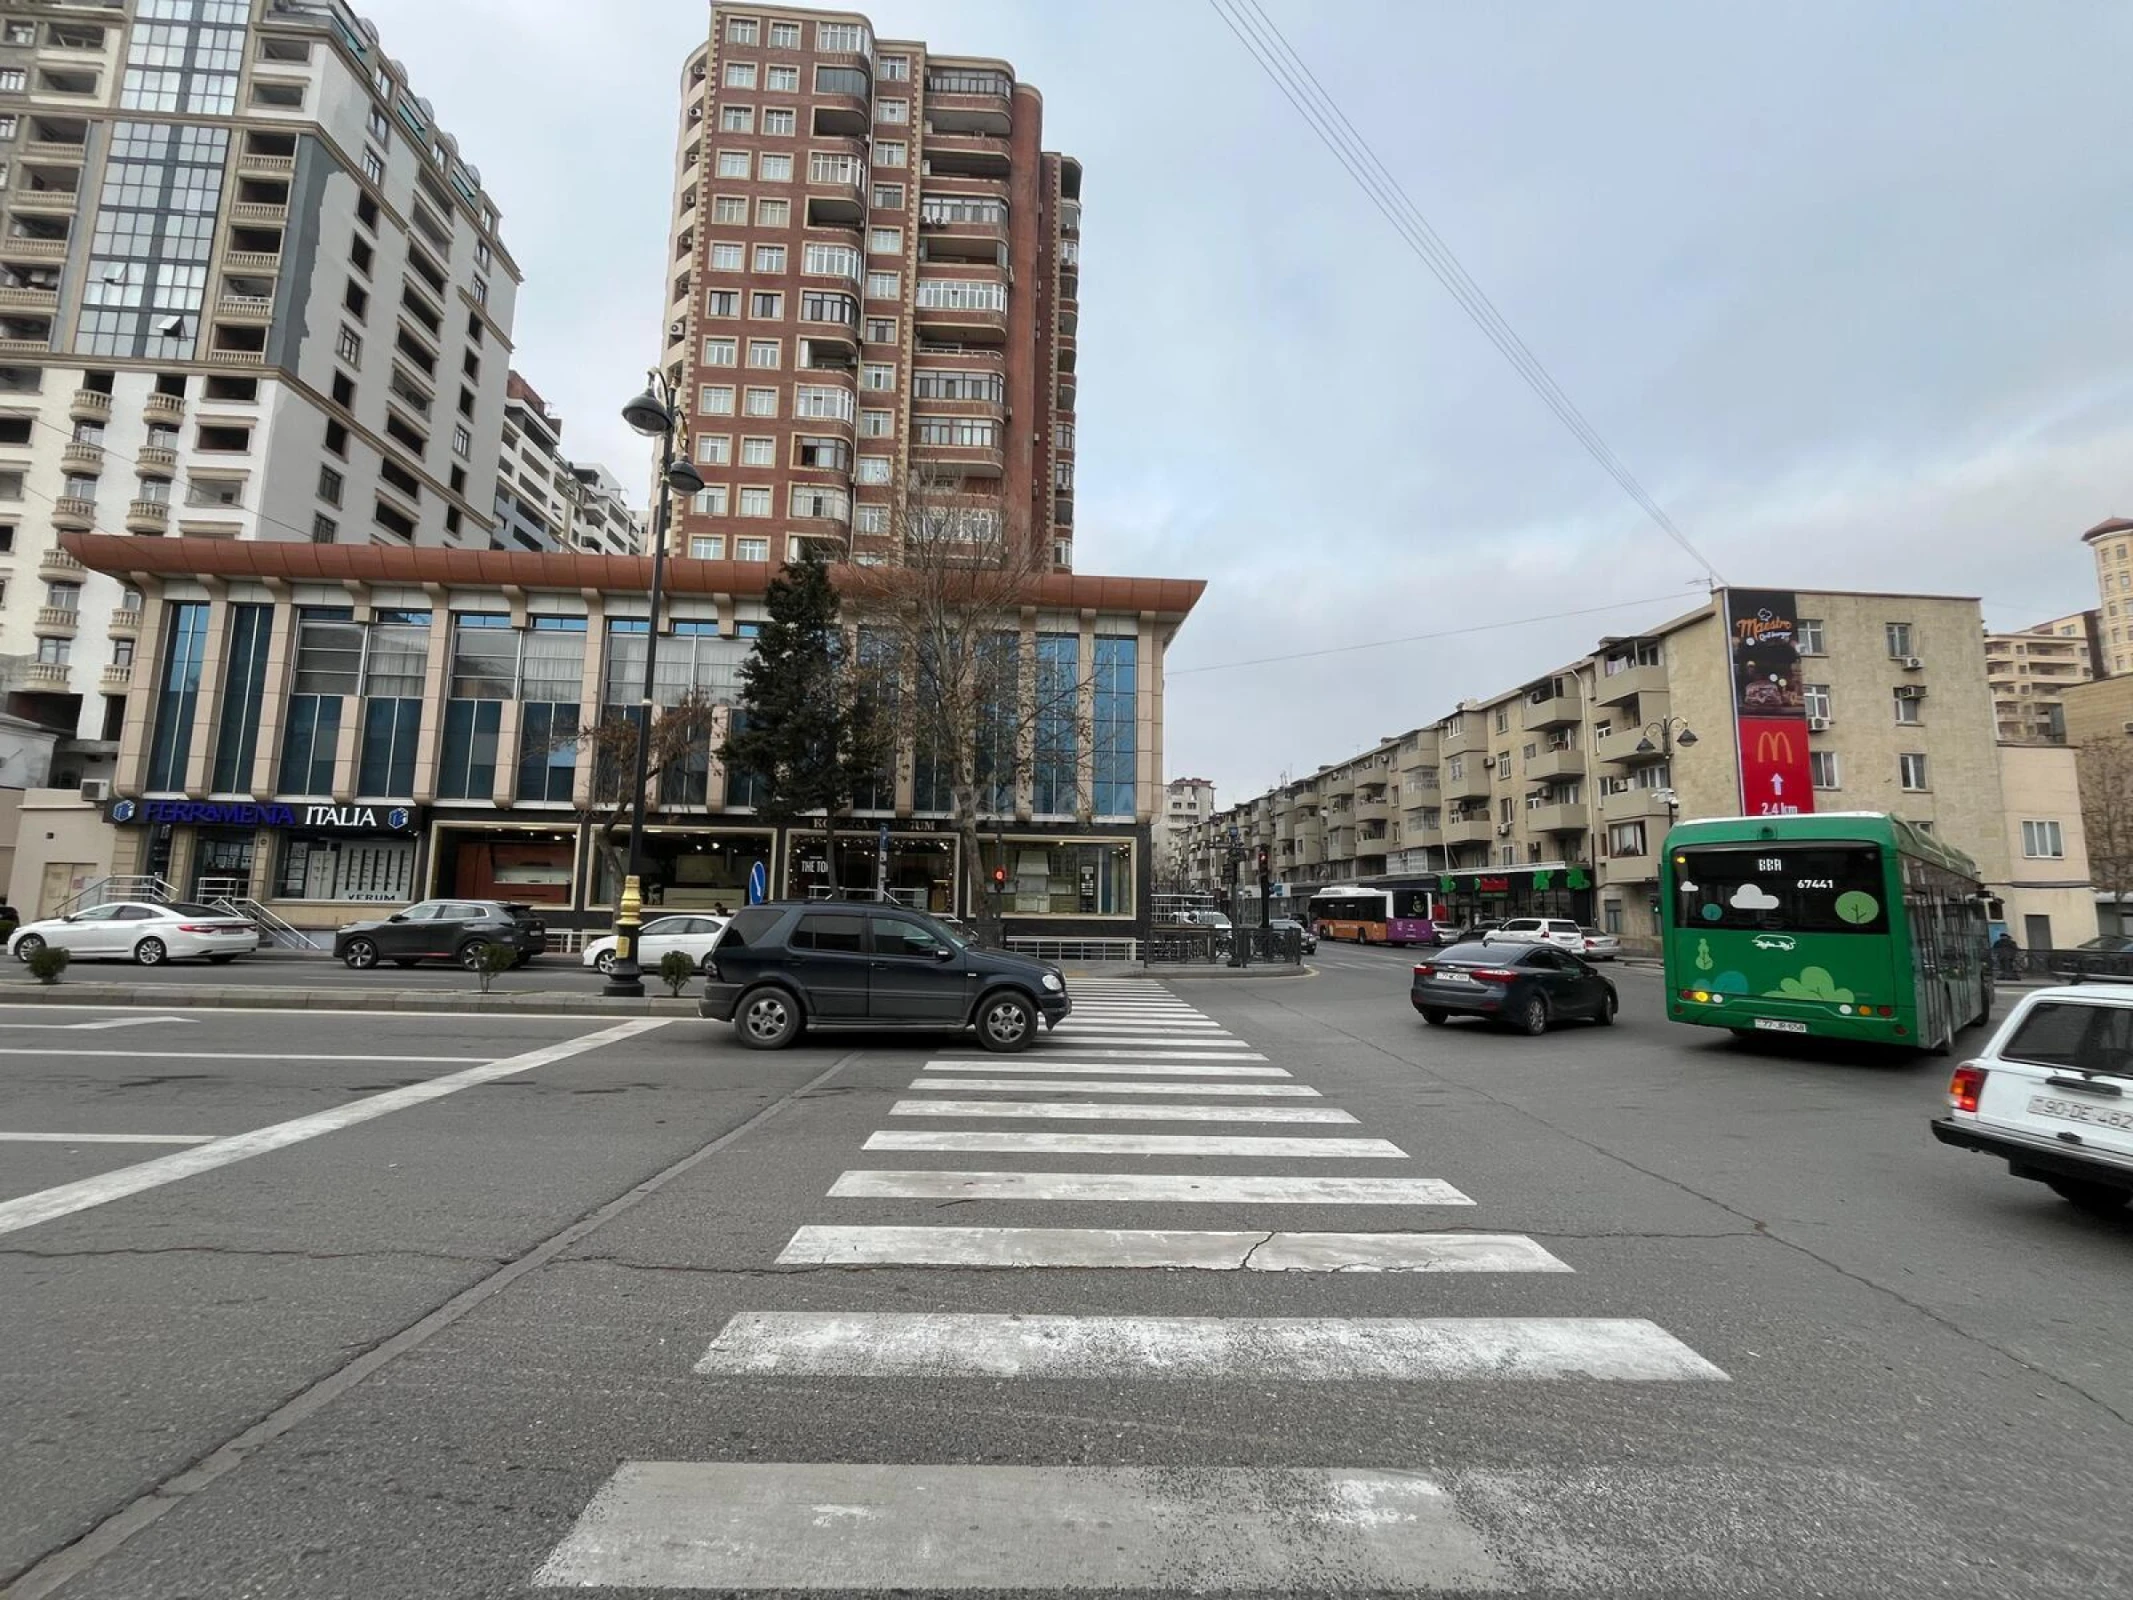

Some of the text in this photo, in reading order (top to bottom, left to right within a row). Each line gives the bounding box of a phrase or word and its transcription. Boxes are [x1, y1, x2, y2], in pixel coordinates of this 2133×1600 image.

[144, 801, 377, 827] FERRAMENTA ITALIA
[801, 860, 815, 873] THE
[1797, 879, 1833, 889] 67441
